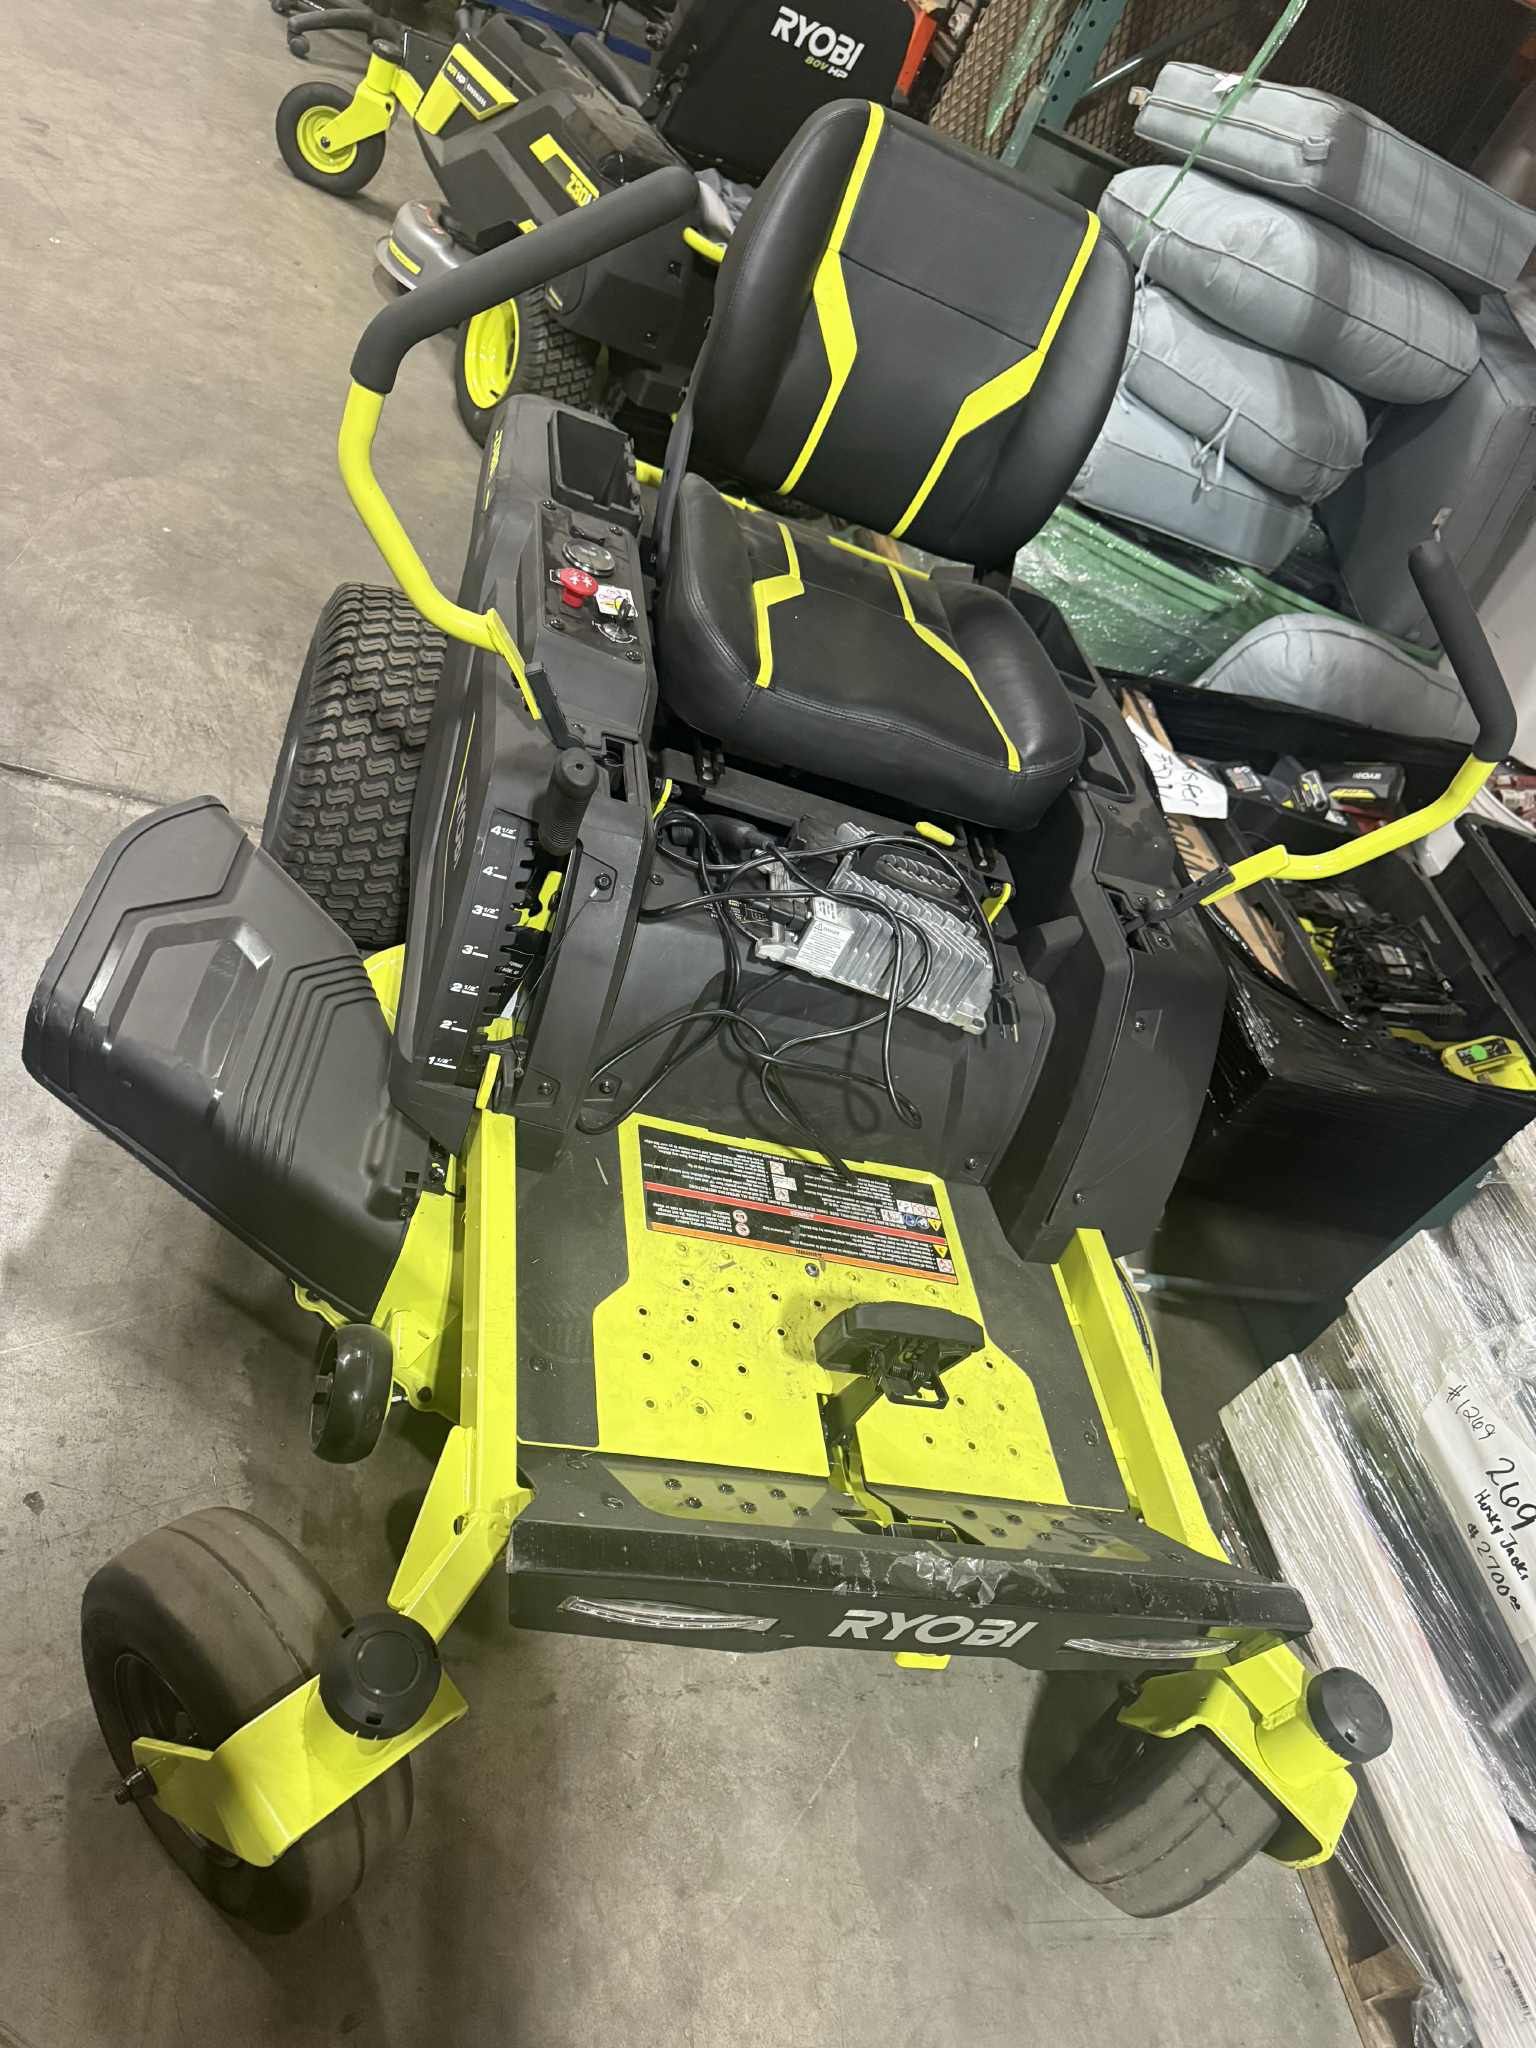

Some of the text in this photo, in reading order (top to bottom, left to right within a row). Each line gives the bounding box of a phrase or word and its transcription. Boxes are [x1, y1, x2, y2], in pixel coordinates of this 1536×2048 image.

[770, 6, 865, 71] RYOBI
[827, 66, 848, 79] HP
[1446, 1384, 1496, 1440] #1269
[1485, 1457, 1536, 1531] 269
[827, 1609, 1039, 1649] RYOBI
